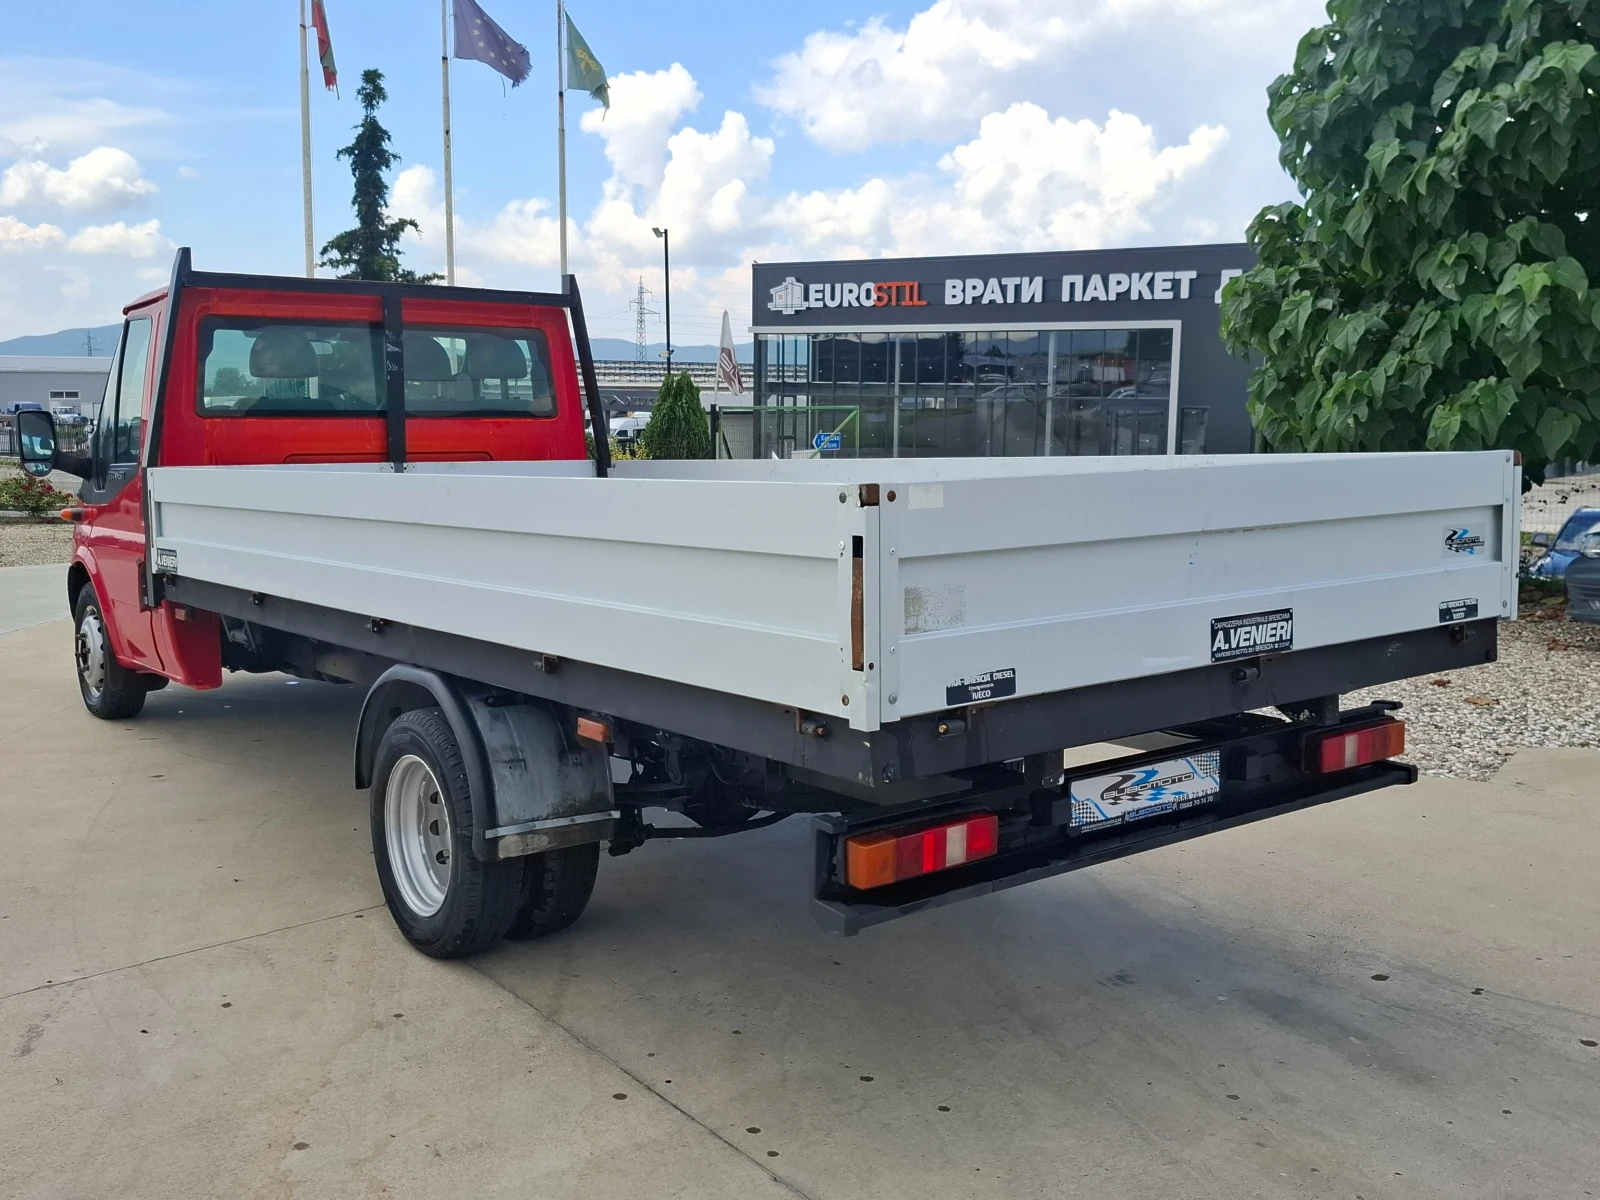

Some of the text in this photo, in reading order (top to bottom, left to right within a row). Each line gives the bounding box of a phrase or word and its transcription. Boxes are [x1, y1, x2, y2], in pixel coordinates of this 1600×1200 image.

[808, 280, 929, 308] EUROSTIL
[944, 275, 1044, 306] ВРАТИ
[1061, 270, 1198, 303] ПАРКЕТ
[1243, 615, 1268, 625] INDUSTRIALE
[1268, 612, 1291, 622] BRESCIANA
[993, 670, 1014, 681] DIESEL
[972, 690, 991, 700] IVECO
[1103, 772, 1194, 800] BUBOMOTO
